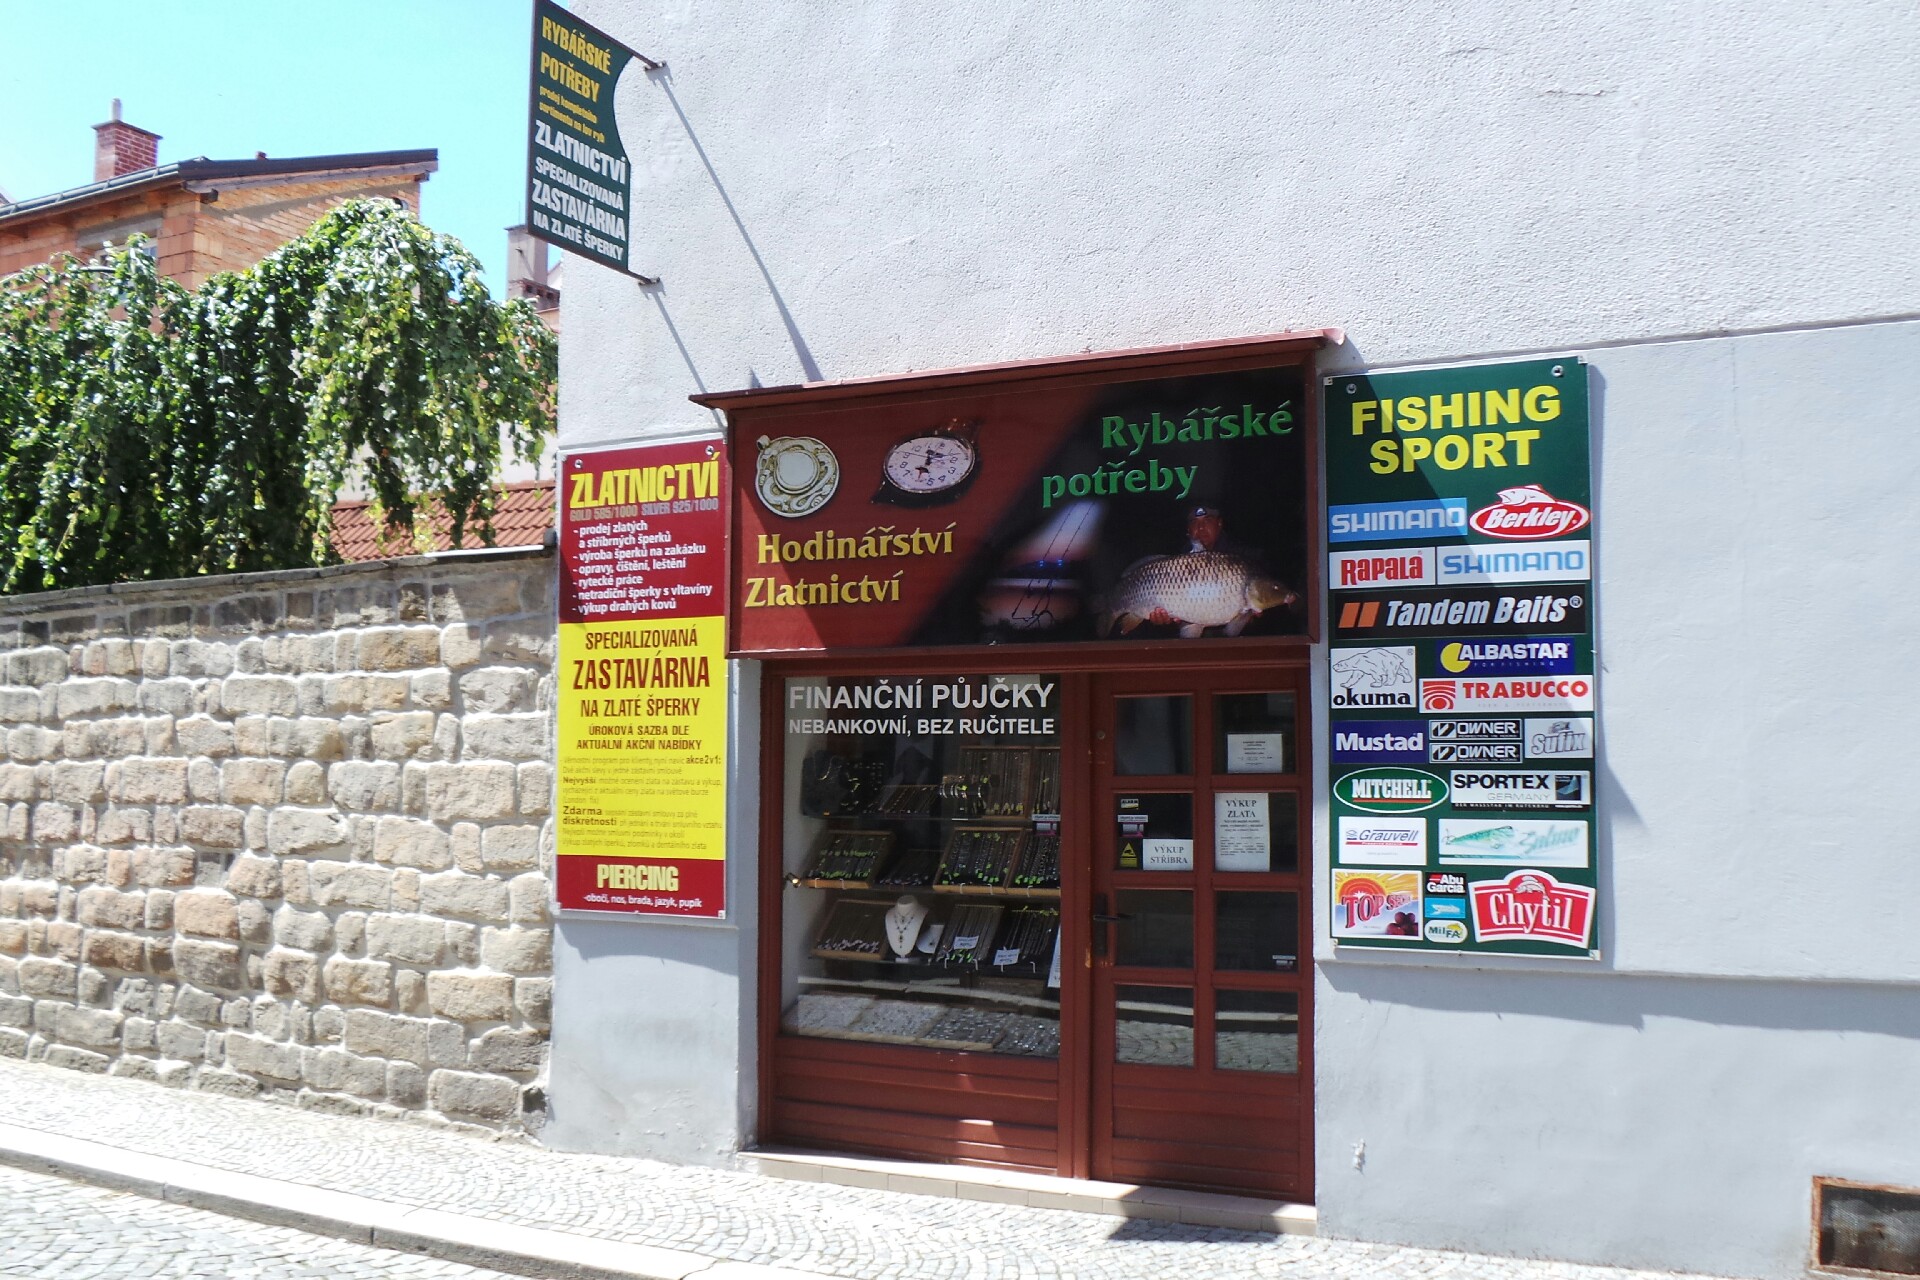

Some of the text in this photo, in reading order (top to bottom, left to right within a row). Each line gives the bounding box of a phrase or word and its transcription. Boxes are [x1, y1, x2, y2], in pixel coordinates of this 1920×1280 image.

[542, 16, 611, 75] RYBÁŘSKÉ
[540, 51, 600, 103] POTŘEBY
[535, 119, 626, 185] ZLATNICTVÍ
[535, 156, 624, 211] SPECIALIZOVANÁ
[531, 178, 626, 241] ZASTAVÁRNA
[533, 209, 624, 262] NA ZLATÉ ŠPERKY
[1351, 385, 1561, 435] FISHING
[1102, 400, 1294, 456] Rybářské
[1369, 429, 1540, 475] SPORT
[569, 452, 721, 509] ZLATNICTVÍ
[1042, 459, 1198, 509] potřeby
[569, 508, 592, 522] GOLD
[641, 501, 671, 516] SILVER
[1331, 507, 1467, 534] SHIMANO
[1483, 508, 1575, 530] Berkley
[579, 520, 648, 536] prodej zlatých
[578, 541, 586, 549] a
[637, 532, 672, 546] šperků
[757, 521, 957, 564] Hodinářství
[578, 543, 706, 564] výroba šperků na zakázku
[1442, 550, 1584, 575] SHIMANO
[578, 574, 644, 589] rytecké práce
[628, 585, 662, 599] šperky
[663, 586, 669, 595] s
[744, 570, 904, 609] Zlatnictví
[578, 597, 677, 616] výkup drahých kovů
[1386, 598, 1490, 626] Tandem
[585, 624, 698, 650] SPECIALIZOVANÁ
[1460, 642, 1569, 661] ALBASTAR
[573, 650, 711, 690] ZASTAVÁRNA
[789, 676, 1055, 709] FINANČNÍ PŮJČKY
[1333, 687, 1411, 706] okuma
[1462, 680, 1589, 699] TRABUCCO
[580, 694, 701, 718] NA ZLATÉ ŠPERKY
[588, 723, 690, 736] ÚROKOVÁ SAZBA DLE
[789, 714, 1055, 737] NEBANKOVNÍ, BEZ RUČITELE
[1457, 722, 1518, 735] OWNER
[576, 738, 623, 750] AKTUÁLNÍ
[1335, 732, 1424, 752] Mustad
[1457, 745, 1518, 759] OWNER
[1531, 730, 1586, 755] Sufix
[1352, 778, 1432, 799] MITCHELL
[1453, 774, 1550, 790] SPORTEX
[1226, 797, 1257, 808] VÝKUP
[1487, 792, 1551, 801] GERMANY
[563, 806, 603, 816] Zdarma
[1227, 810, 1256, 818] ZLATA
[1359, 830, 1419, 842] Grauvell
[1150, 854, 1188, 864] STŘÍBRA
[1154, 844, 1184, 854] VÝKUP
[596, 864, 679, 892] PIERCING
[1427, 882, 1464, 894] Garcia
[1440, 874, 1464, 885] Abu
[1341, 894, 1385, 929] TOP
[1490, 892, 1573, 934] Chytil
